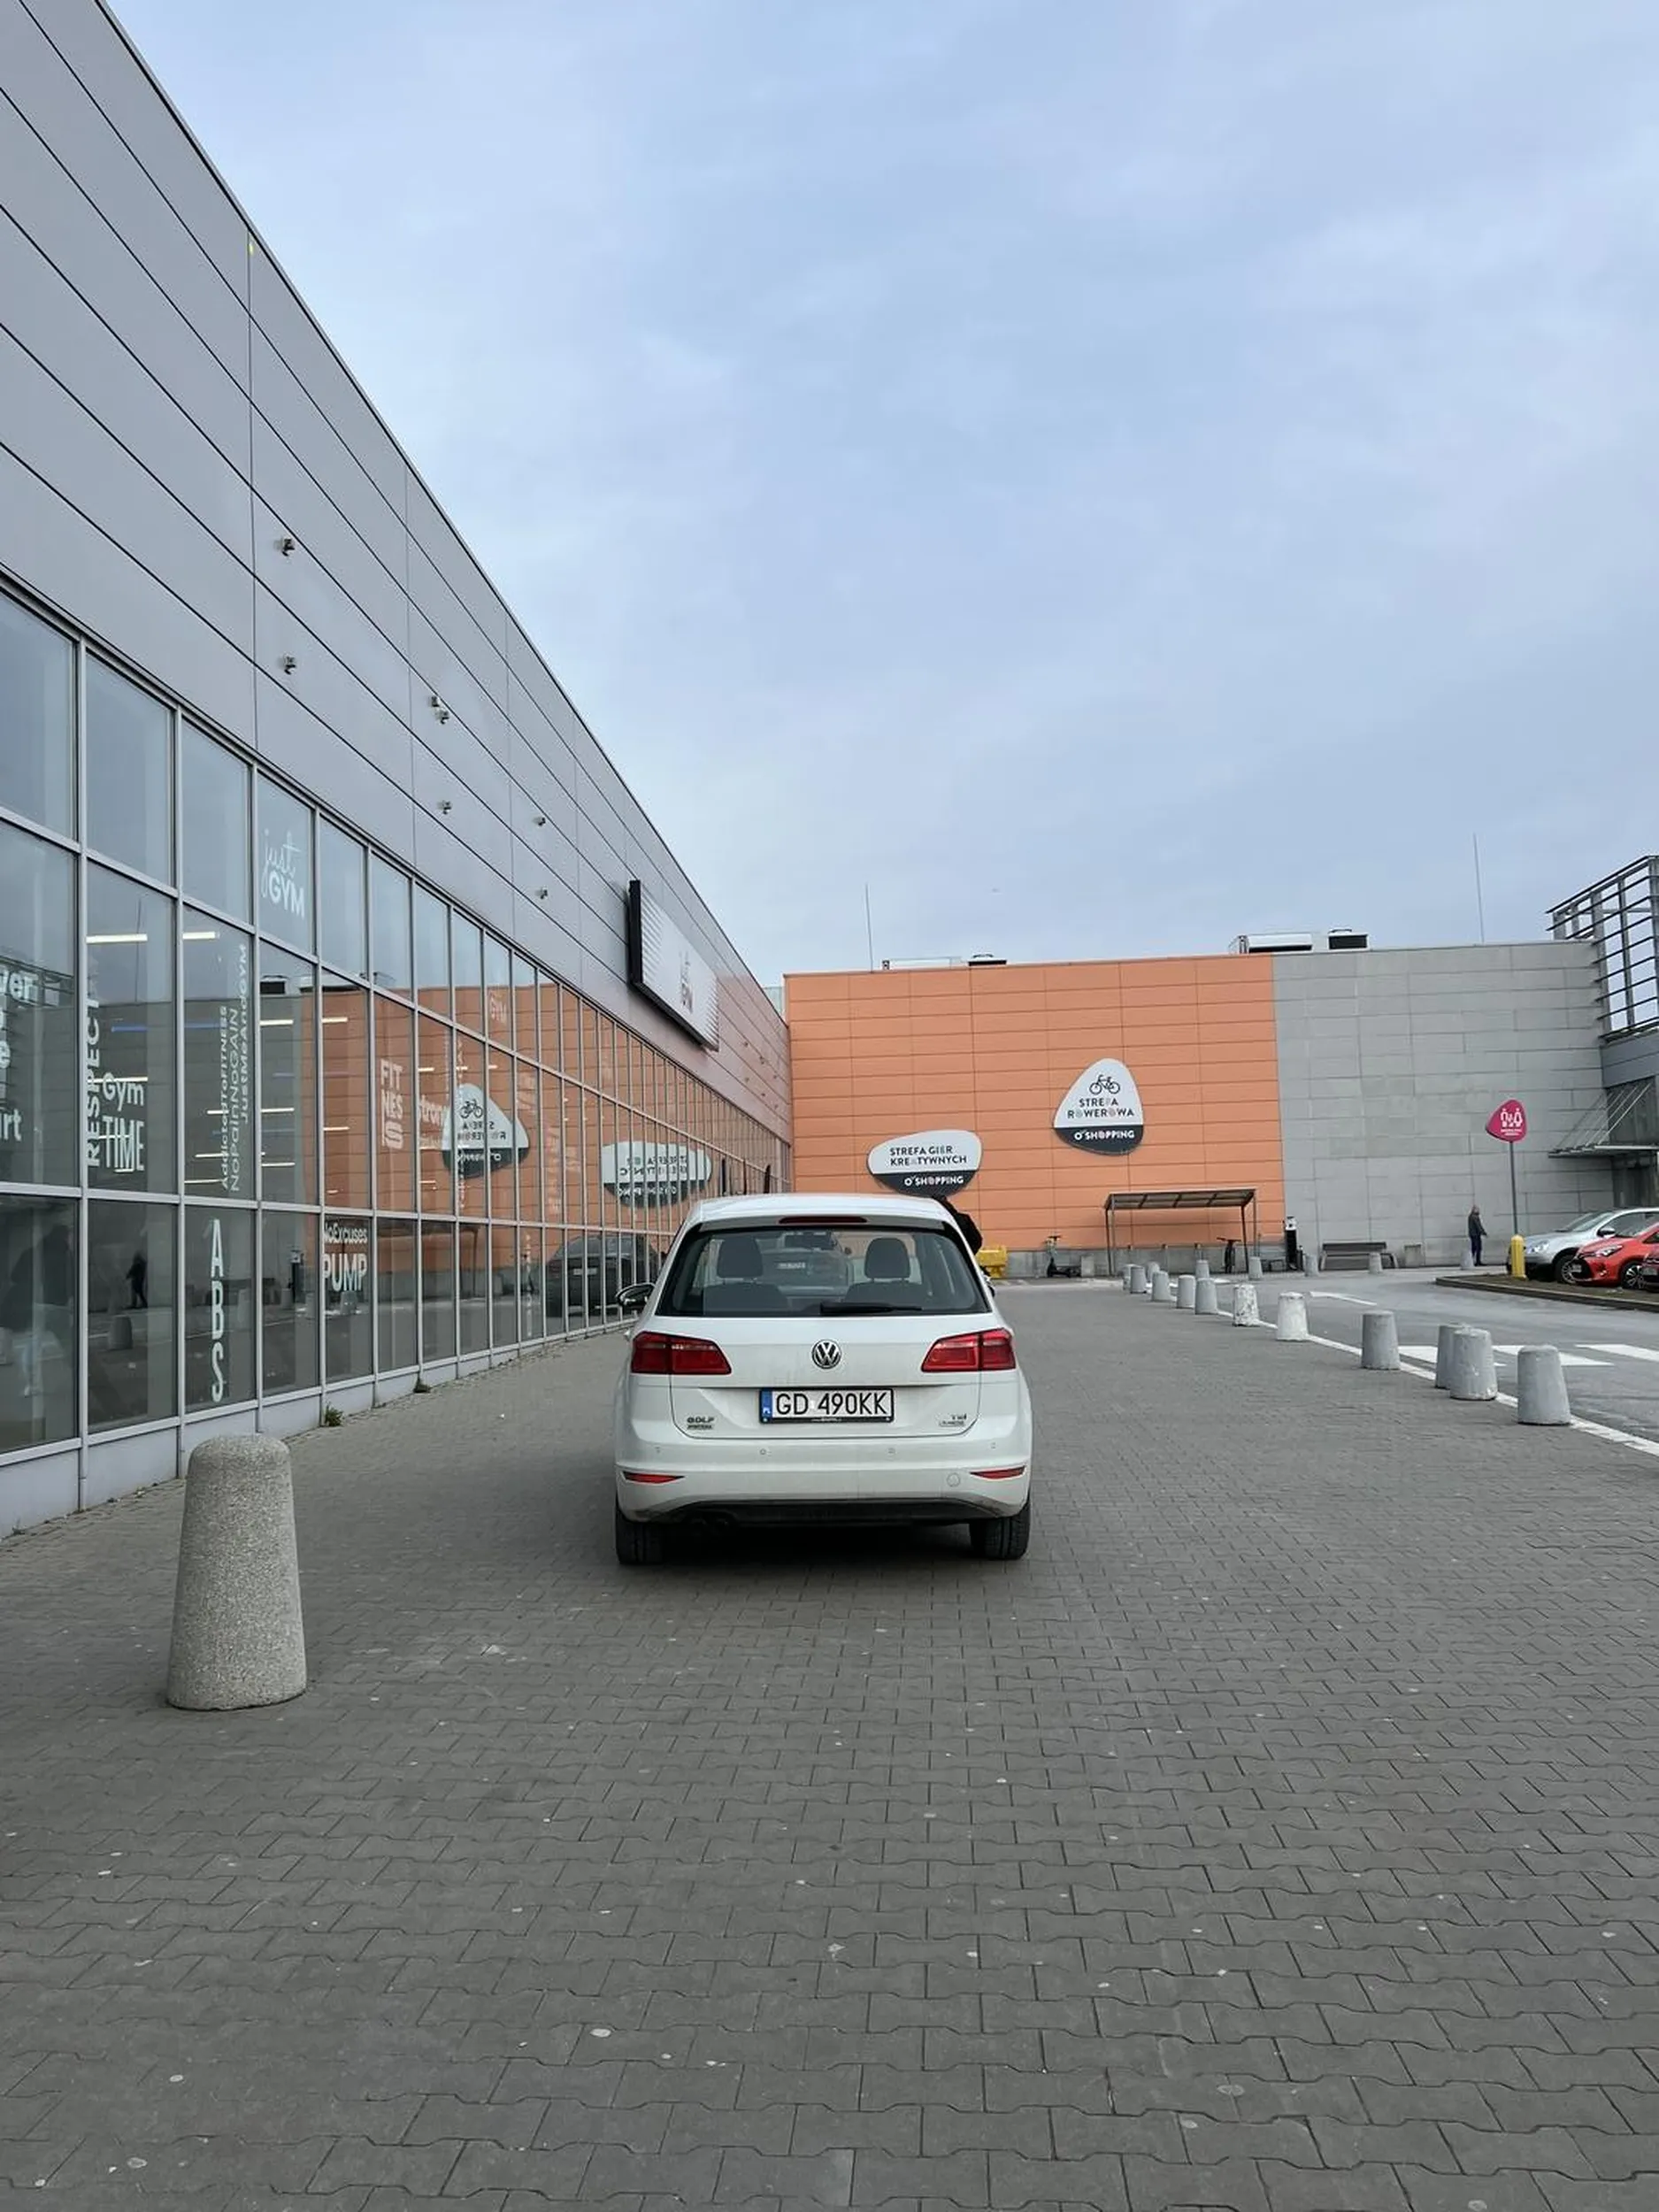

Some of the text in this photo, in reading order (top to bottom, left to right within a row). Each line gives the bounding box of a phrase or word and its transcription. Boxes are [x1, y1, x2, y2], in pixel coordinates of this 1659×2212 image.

[269, 871, 304, 918] GYM
[87, 993, 100, 1167] RESPECT
[103, 1072, 144, 1111] Gym
[380, 1059, 403, 1091] FIT
[103, 1115, 145, 1171] TIME
[890, 1147, 926, 1156] STREFA
[321, 1253, 368, 1292] PUMP
[211, 1218, 225, 1403] ABS
[776, 1392, 887, 1416] GD 490KK
